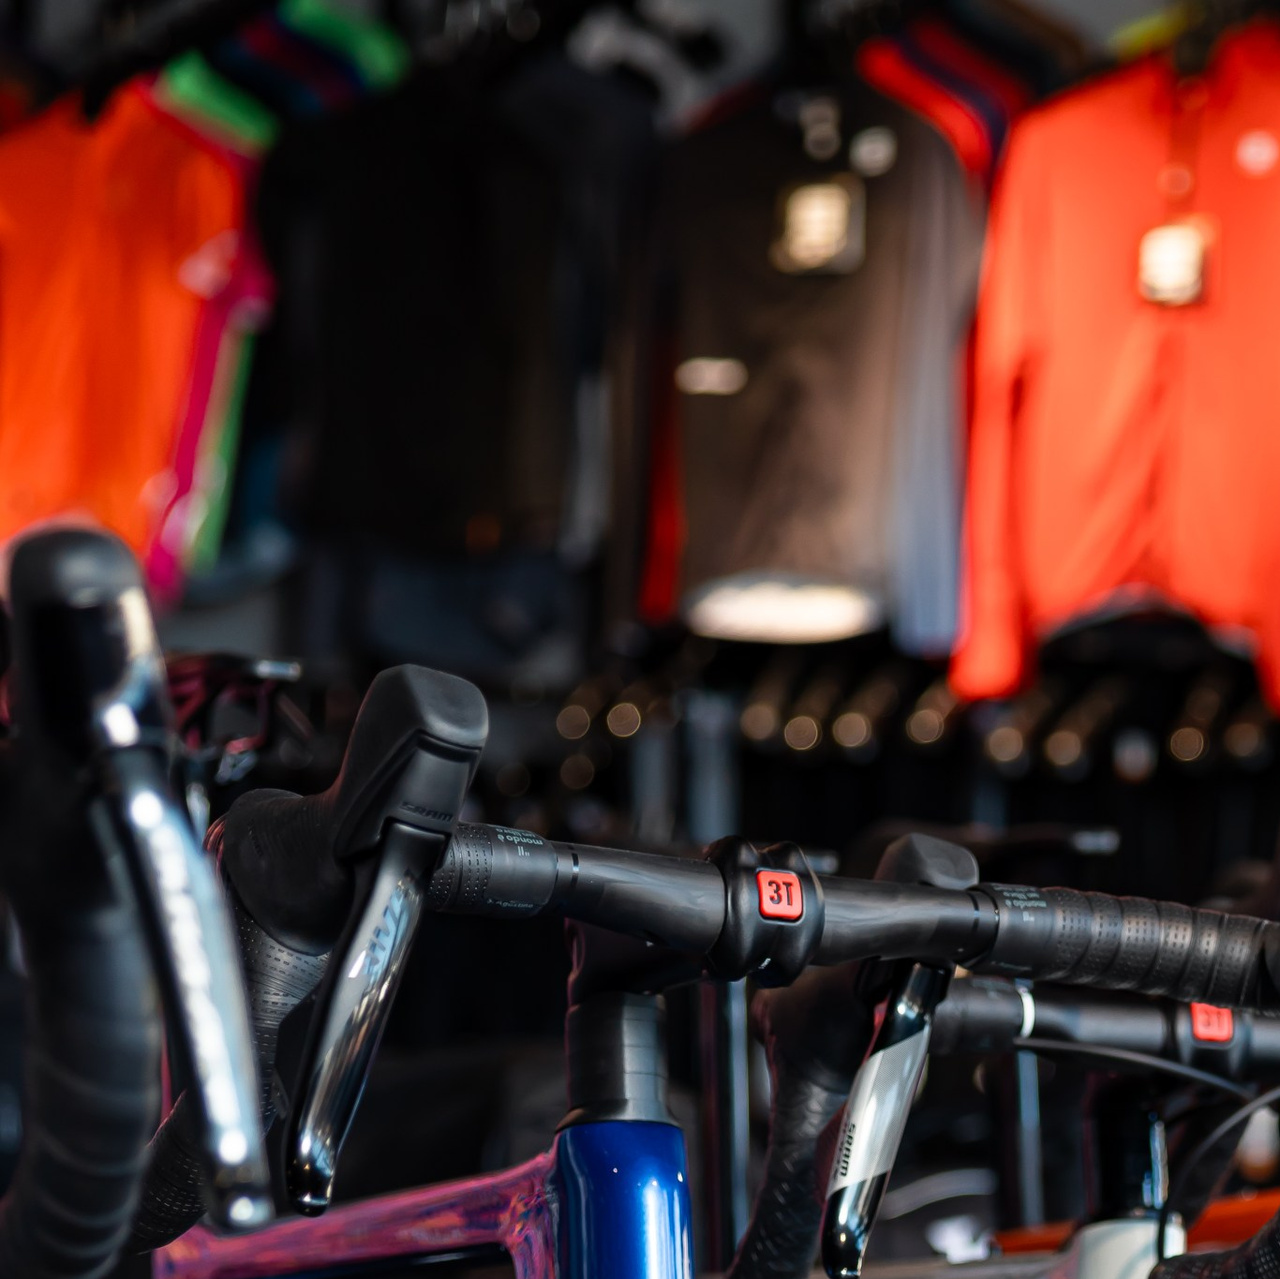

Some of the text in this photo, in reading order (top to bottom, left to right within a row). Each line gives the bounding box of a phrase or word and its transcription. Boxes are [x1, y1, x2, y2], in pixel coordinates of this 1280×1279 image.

[401, 801, 454, 821] SRAM
[506, 835, 543, 846] mondo
[768, 880, 793, 907] 3T
[840, 1122, 856, 1178] SRAM
